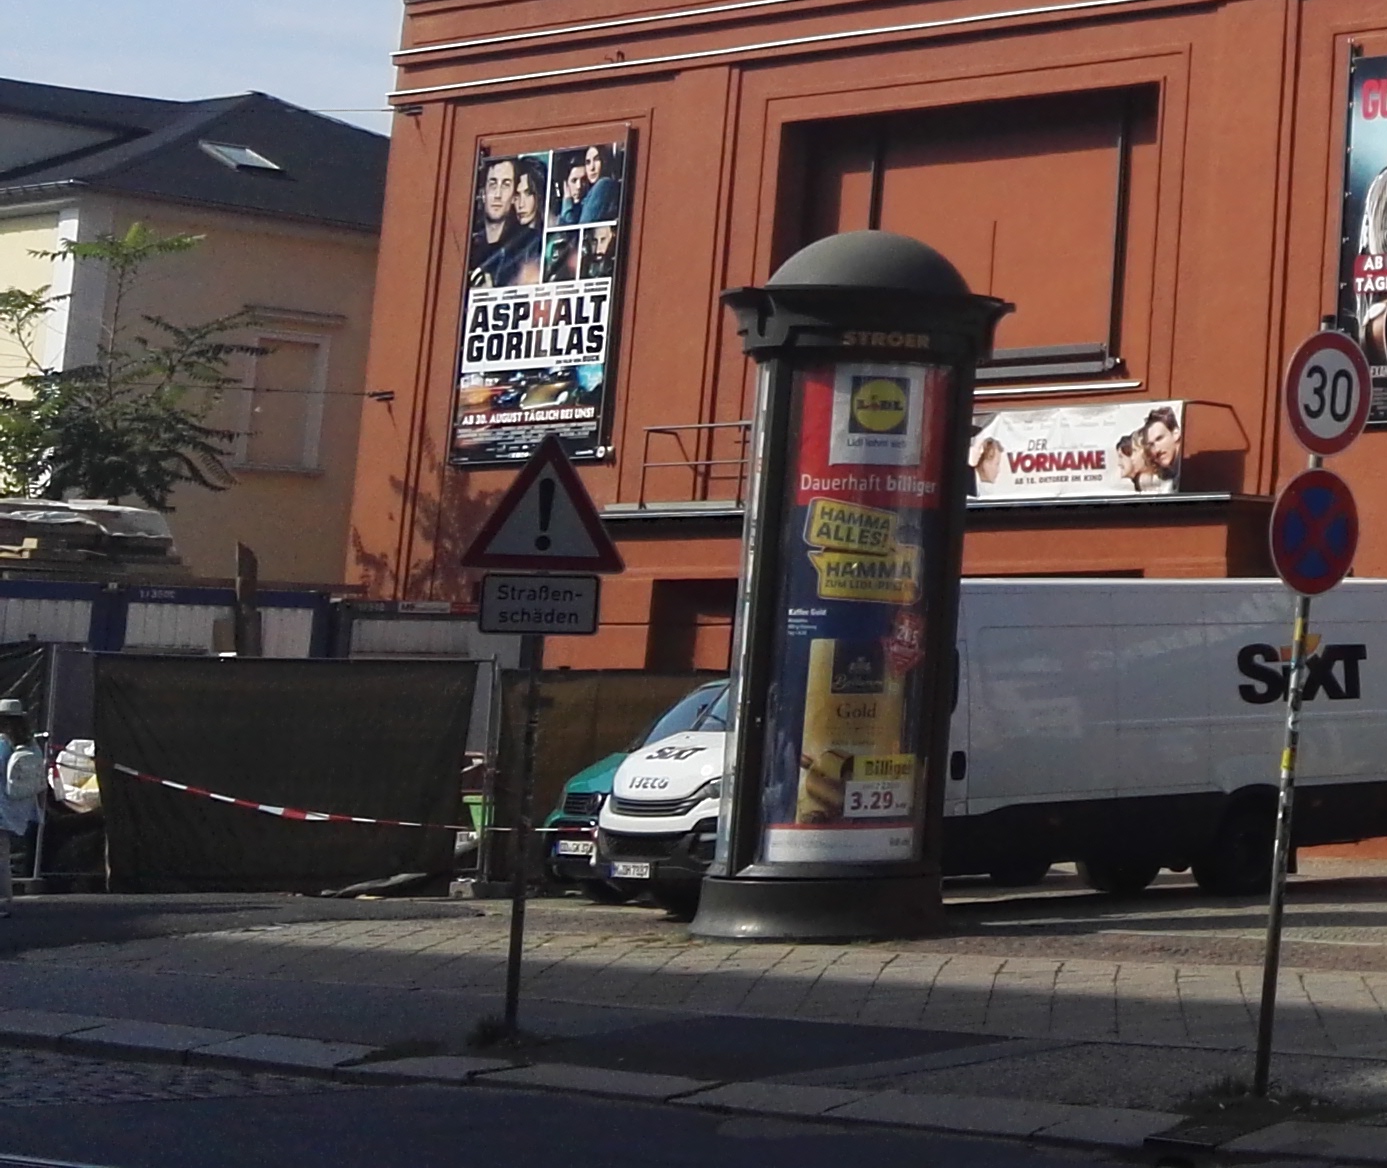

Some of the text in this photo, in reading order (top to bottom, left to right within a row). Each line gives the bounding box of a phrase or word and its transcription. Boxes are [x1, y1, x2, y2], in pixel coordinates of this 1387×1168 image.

[1364, 257, 1381, 271] AB
[469, 294, 607, 334] ASPHALT
[466, 324, 605, 363] GORILLAS
[1303, 364, 1354, 423] 30
[489, 412, 522, 424] AUGUST
[1027, 438, 1048, 451] DER
[1007, 450, 1106, 474] VORNAME
[800, 473, 936, 496] Dauerhaft billiger
[820, 505, 891, 530] HAMMA
[816, 522, 889, 548] ALLES!
[826, 561, 913, 578] HAMMA
[497, 584, 583, 601] Straßen-
[498, 608, 579, 624] schäden
[837, 702, 877, 719] Gold
[850, 790, 895, 811] 3.29
